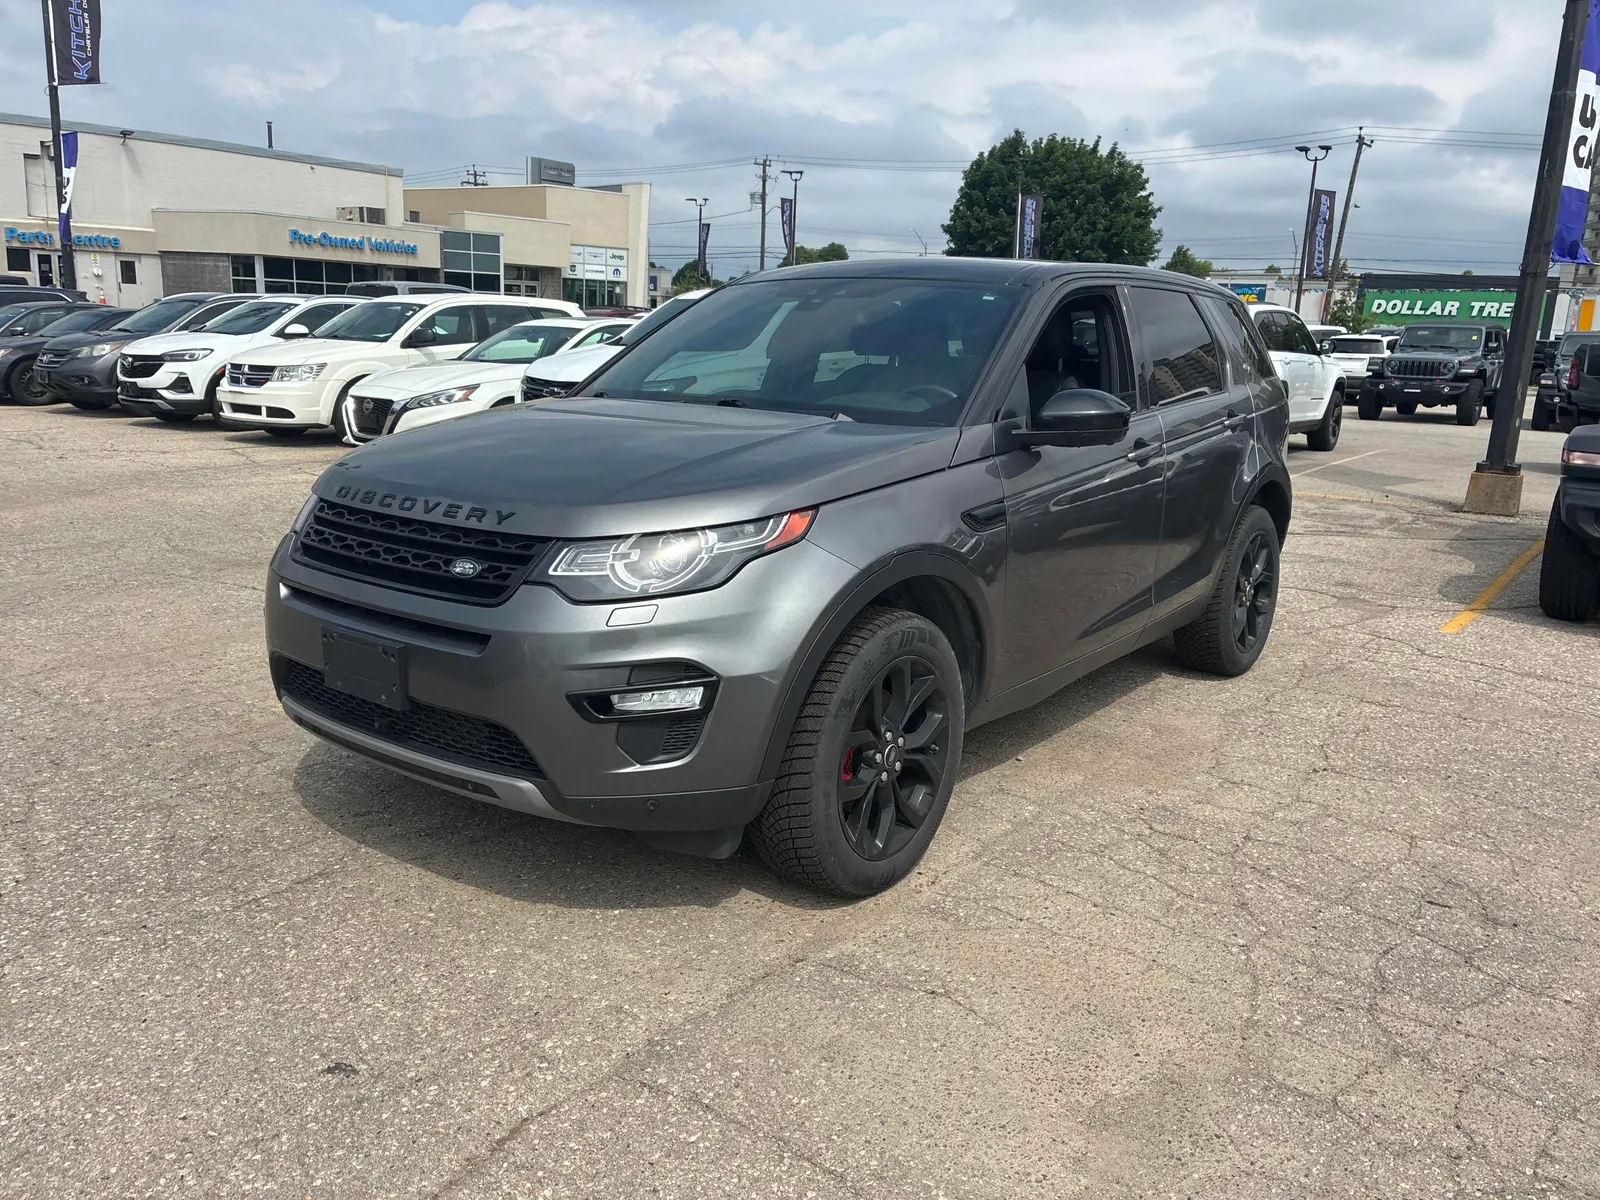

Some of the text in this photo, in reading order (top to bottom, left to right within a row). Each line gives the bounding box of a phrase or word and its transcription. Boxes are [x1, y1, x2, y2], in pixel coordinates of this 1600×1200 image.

[83, 12, 92, 57] CHRYSLER
[4, 226, 121, 248] Parts entre
[289, 229, 418, 254] Pre-Owned Vehicles
[609, 252, 625, 261] Jeep
[1371, 299, 1515, 317] DOLLAR TRE
[335, 485, 517, 526] DISCOVERY
